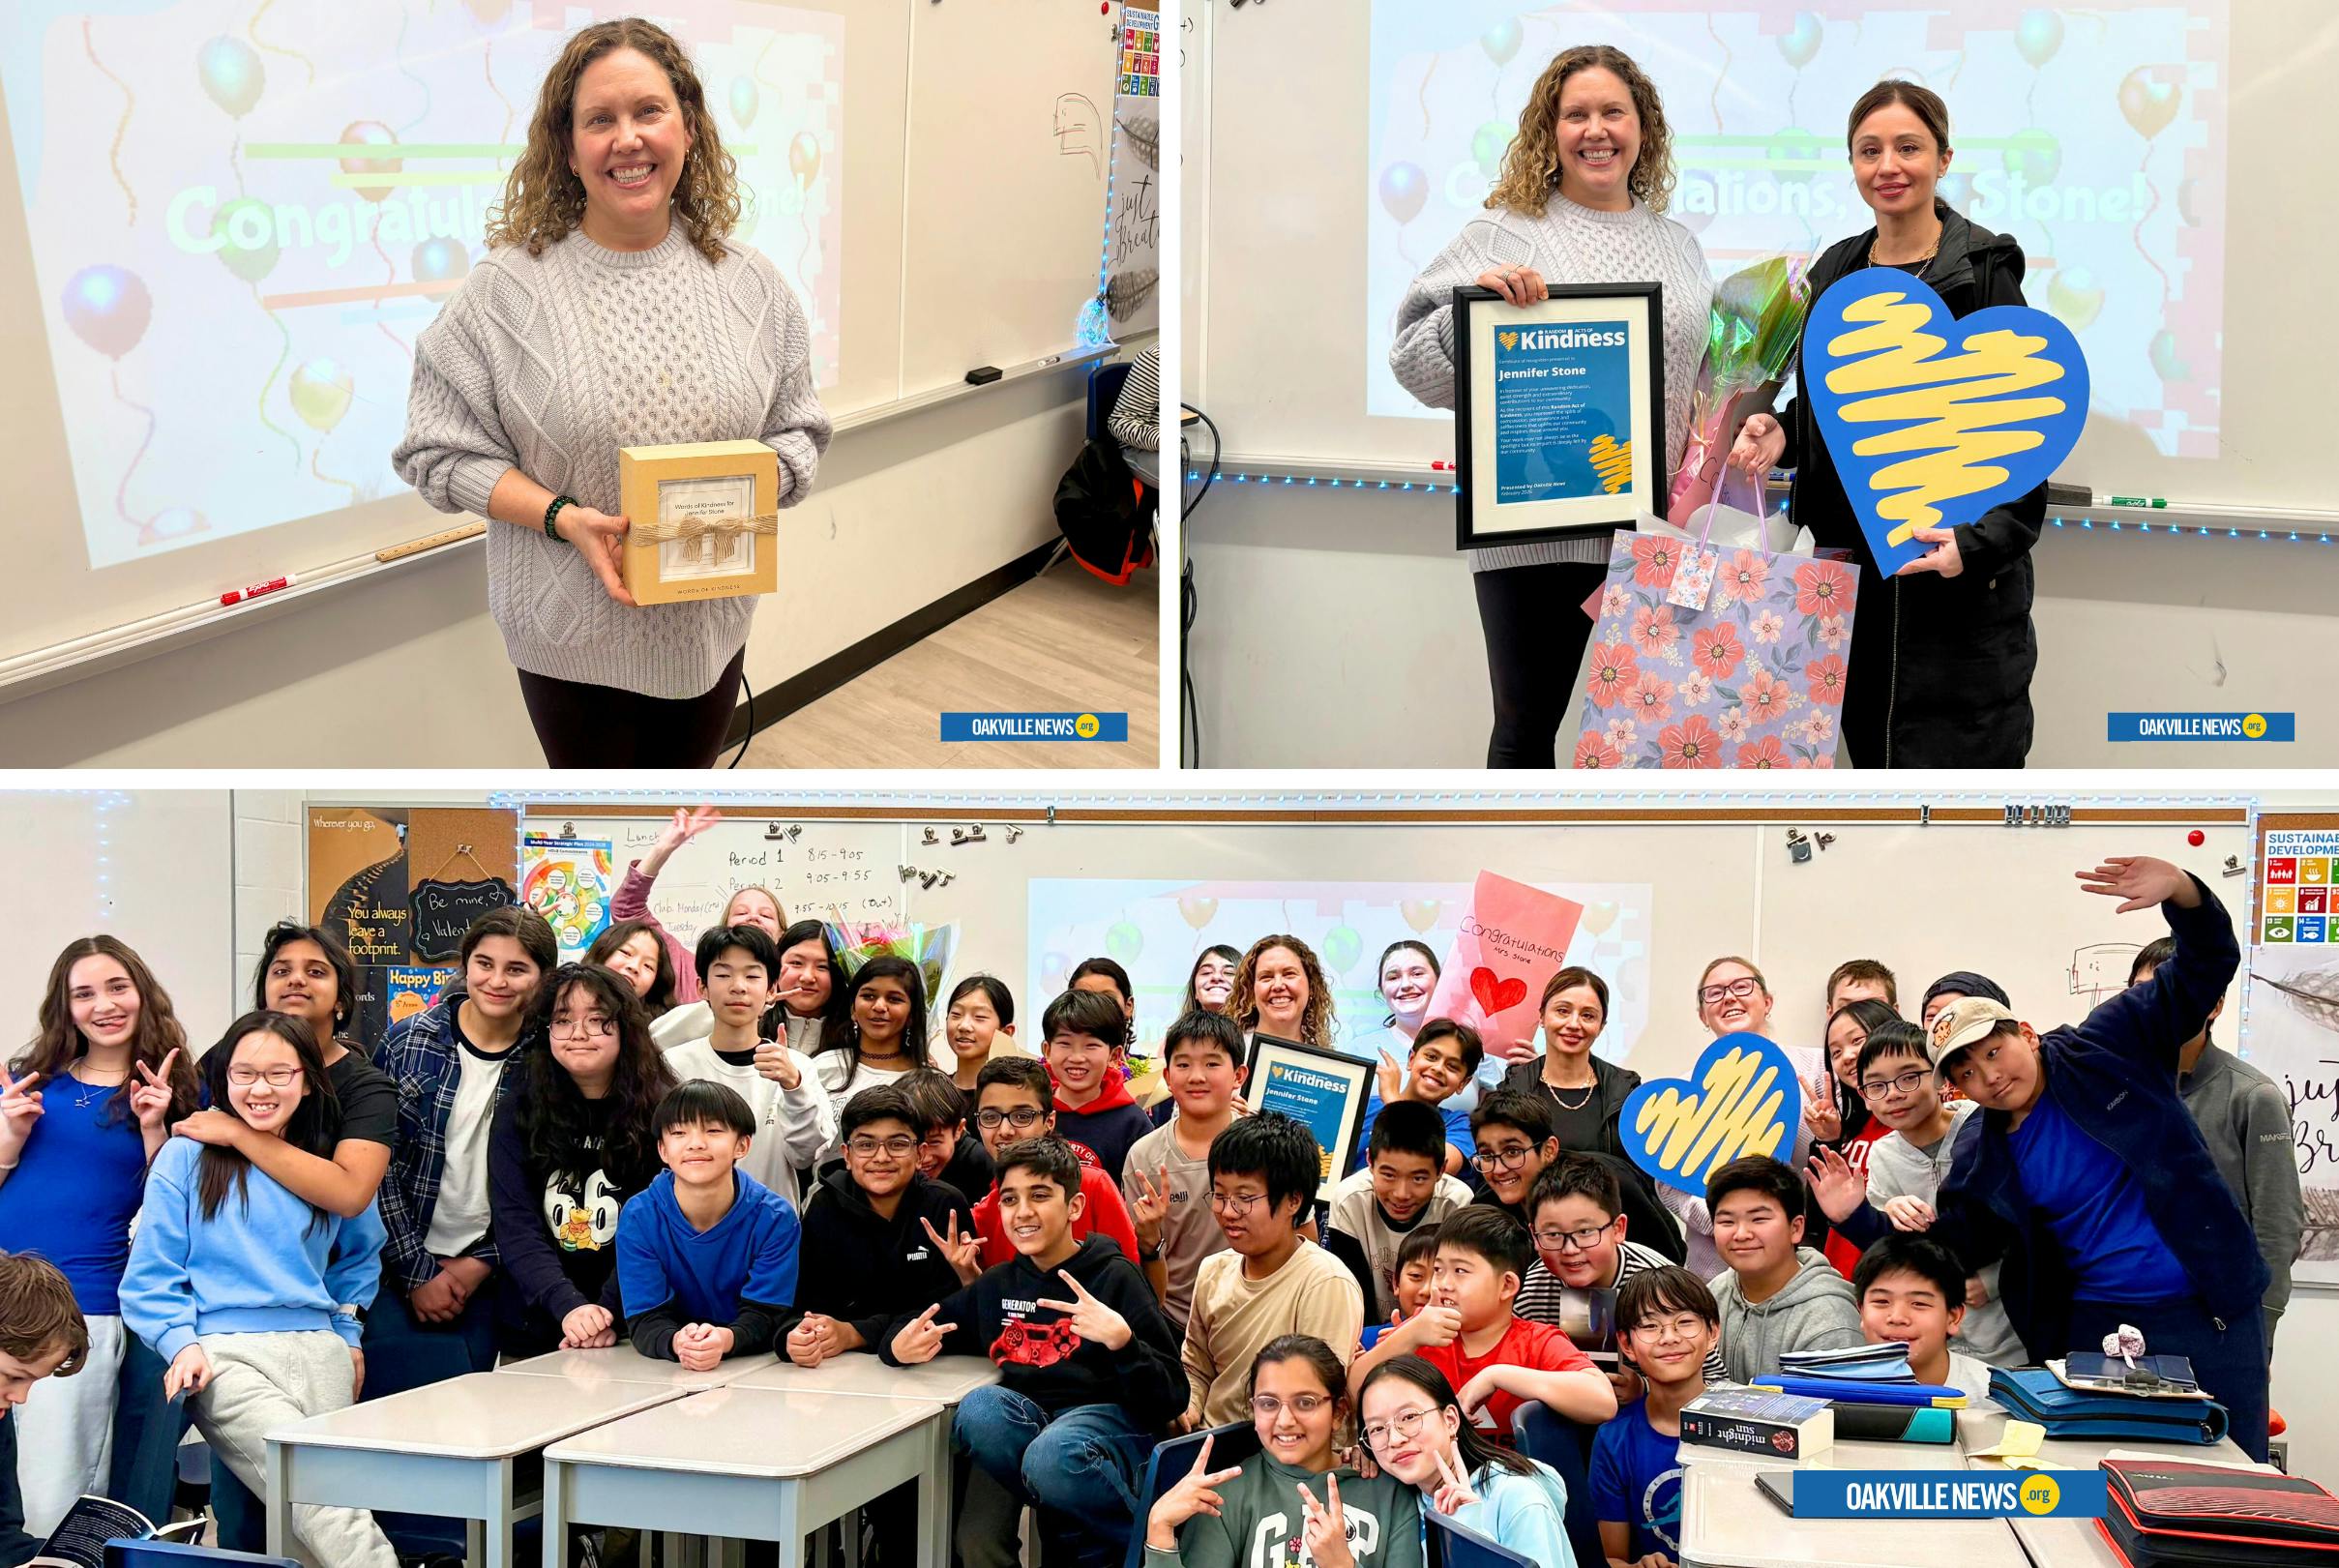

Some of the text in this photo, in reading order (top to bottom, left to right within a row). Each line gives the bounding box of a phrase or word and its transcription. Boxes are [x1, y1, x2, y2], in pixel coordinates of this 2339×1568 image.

[1126, 9, 1153, 20] SUSTAINABLE
[1126, 19, 1153, 30] DEVELOPMENT
[1969, 169, 2147, 222] Stone!
[165, 185, 486, 269] Congratul
[1112, 210, 1159, 267] Breat
[1521, 329, 1625, 350] Kindness
[1498, 367, 1586, 382] Jennifer Stone
[313, 816, 375, 833] Wherever you go,
[728, 851, 766, 867] Period
[777, 848, 785, 863] 1
[2268, 845, 2339, 855] DEVELOPME
[729, 878, 765, 890] Period
[775, 878, 783, 890] 2
[429, 893, 489, 910] Be mine,
[348, 902, 407, 926] You always
[348, 919, 385, 938] leave a
[432, 920, 472, 936] Valent
[1461, 916, 1564, 962] Congratulations
[348, 937, 401, 962] footprint.
[1494, 947, 1531, 963] Mrs Stone
[389, 969, 452, 988] Happy Bir
[355, 991, 375, 1002] ords
[1284, 1069, 1347, 1093] Kindness
[1265, 1087, 1296, 1100] Jennifer
[1297, 1094, 1318, 1105] Stone
[1085, 1152, 1095, 1161] OF
[1001, 1298, 1037, 1314] GENERATOR
[1717, 1430, 1765, 1446] midnight
[1735, 1424, 1755, 1435] sun
